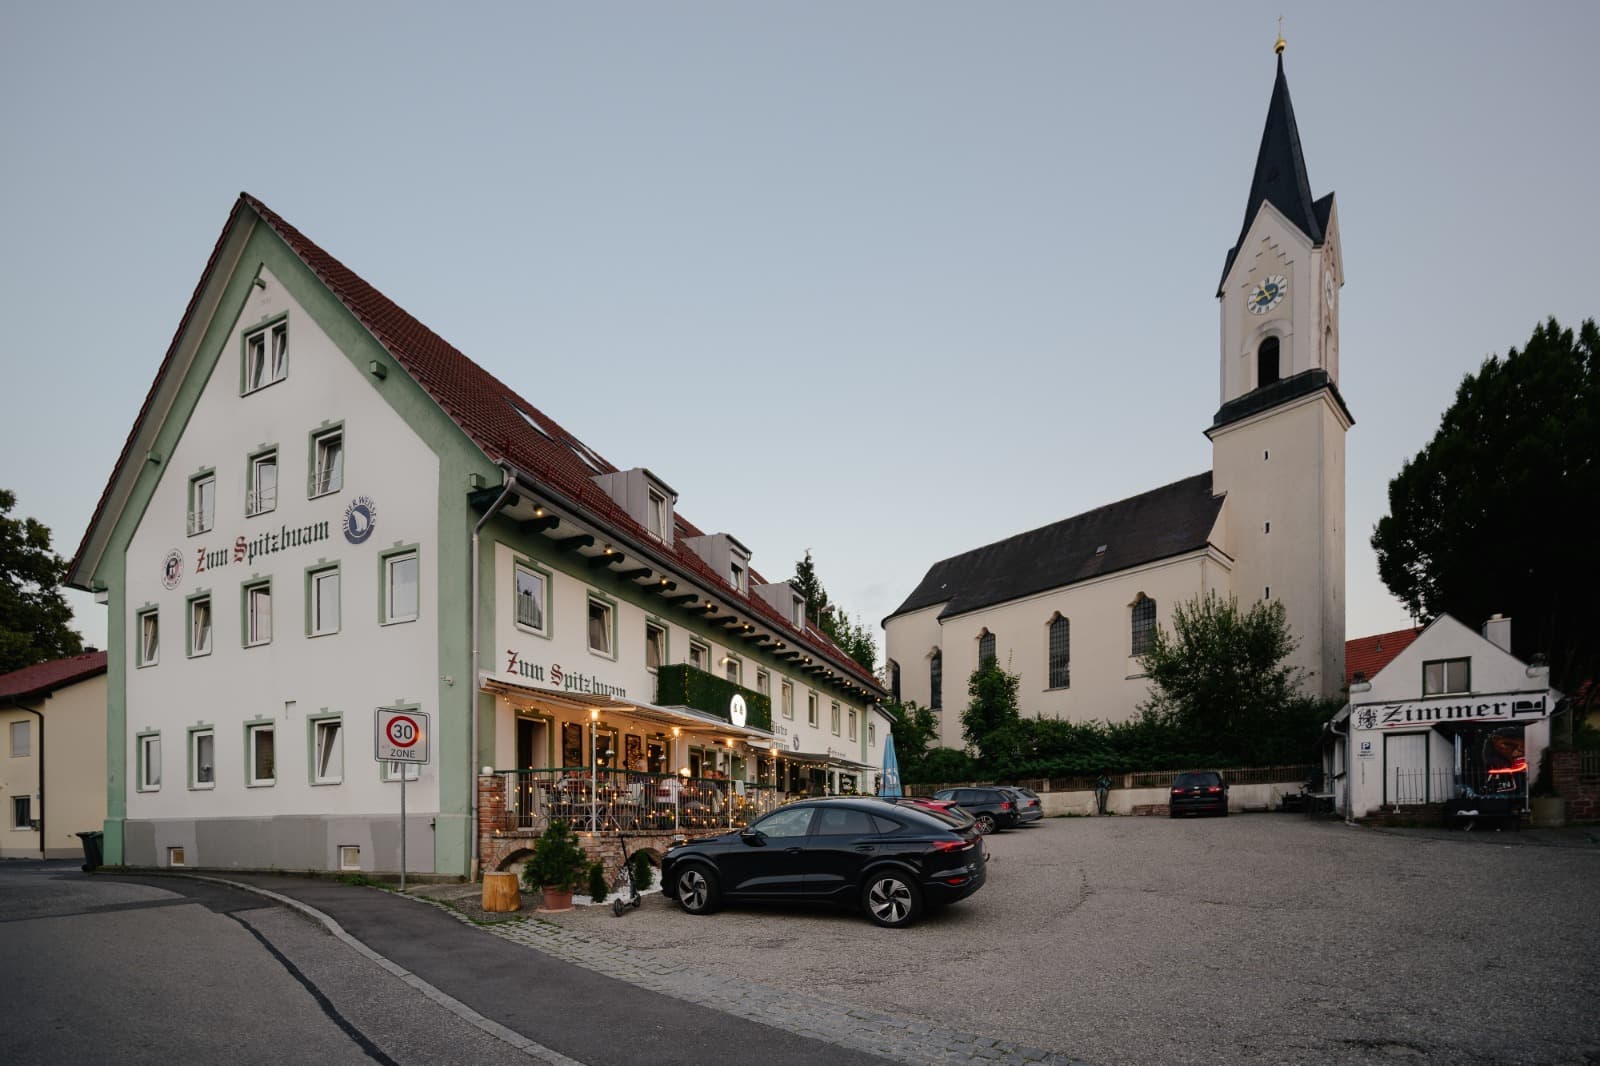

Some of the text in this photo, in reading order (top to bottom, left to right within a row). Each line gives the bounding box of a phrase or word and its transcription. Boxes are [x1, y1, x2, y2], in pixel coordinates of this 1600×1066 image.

[195, 546, 229, 574] Zum
[233, 521, 329, 566] Spitzbuam
[506, 649, 627, 698] Zum Spitzbuam
[1381, 700, 1508, 724] Zimmer
[393, 724, 413, 740] 30
[390, 748, 416, 759] ZONE
